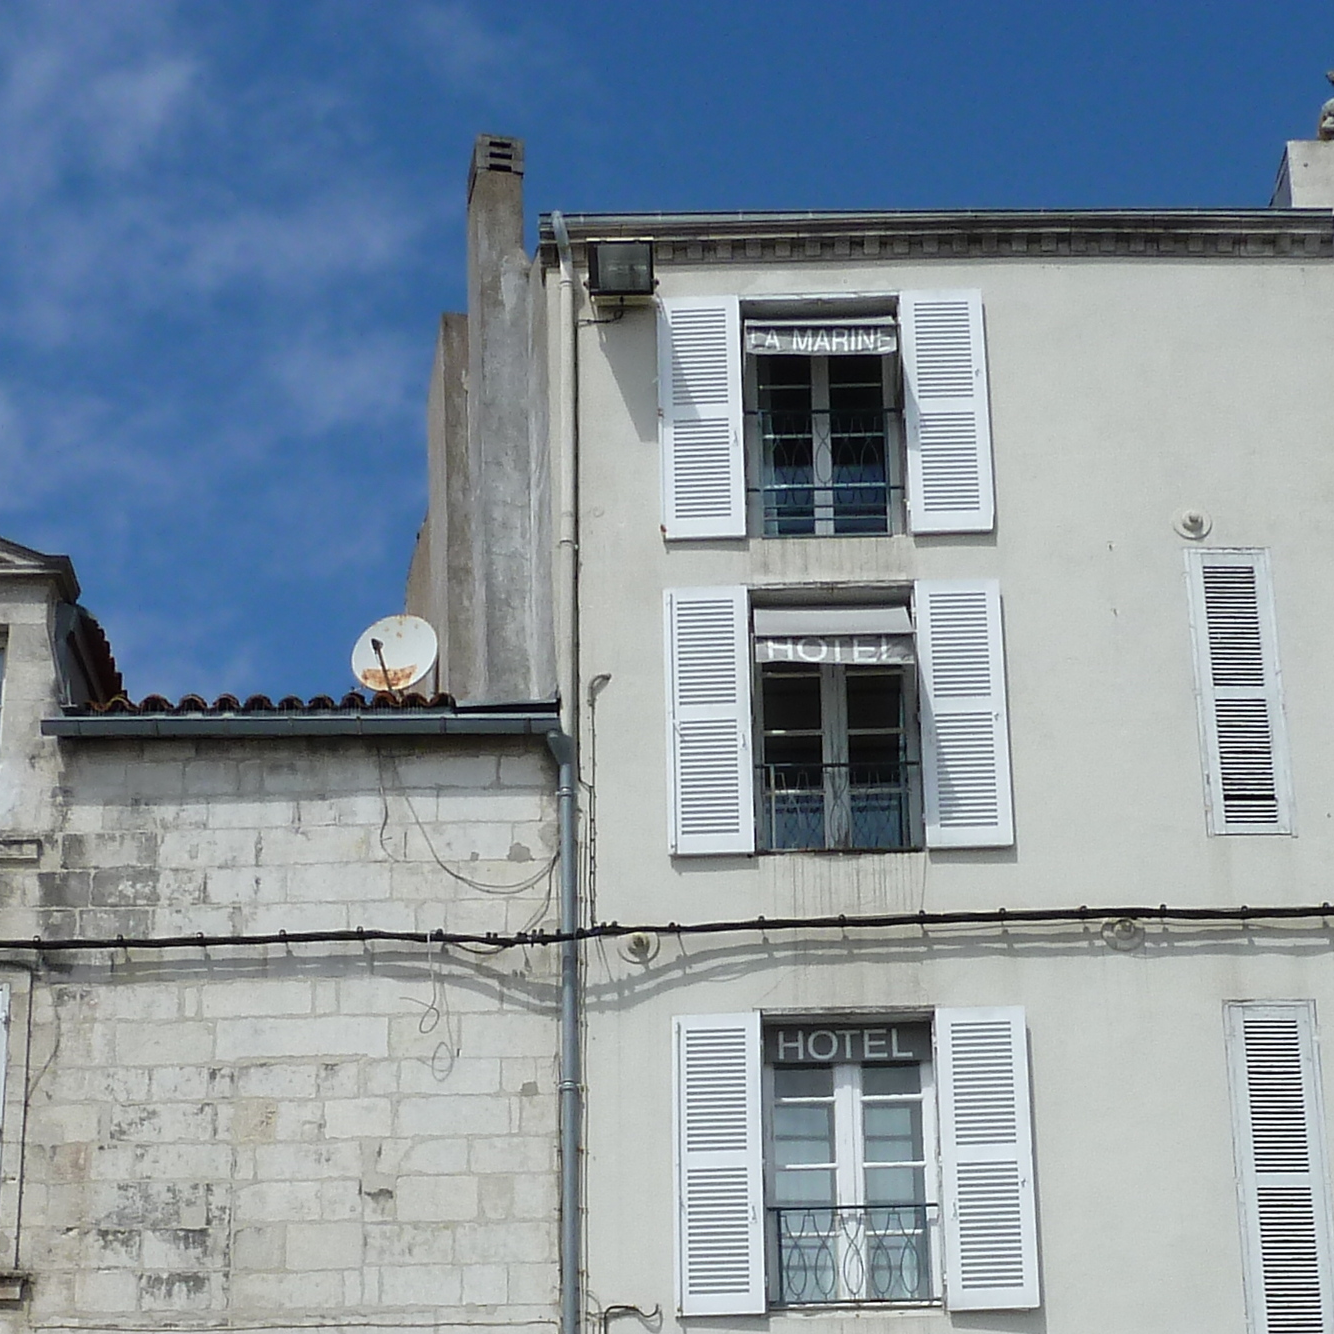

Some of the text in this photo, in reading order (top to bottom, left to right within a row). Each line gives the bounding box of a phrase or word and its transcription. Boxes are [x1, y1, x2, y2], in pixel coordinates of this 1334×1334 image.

[750, 328, 892, 352] LA MARINE
[767, 636, 902, 662] HOTEL
[778, 1028, 913, 1060] HOTEL
